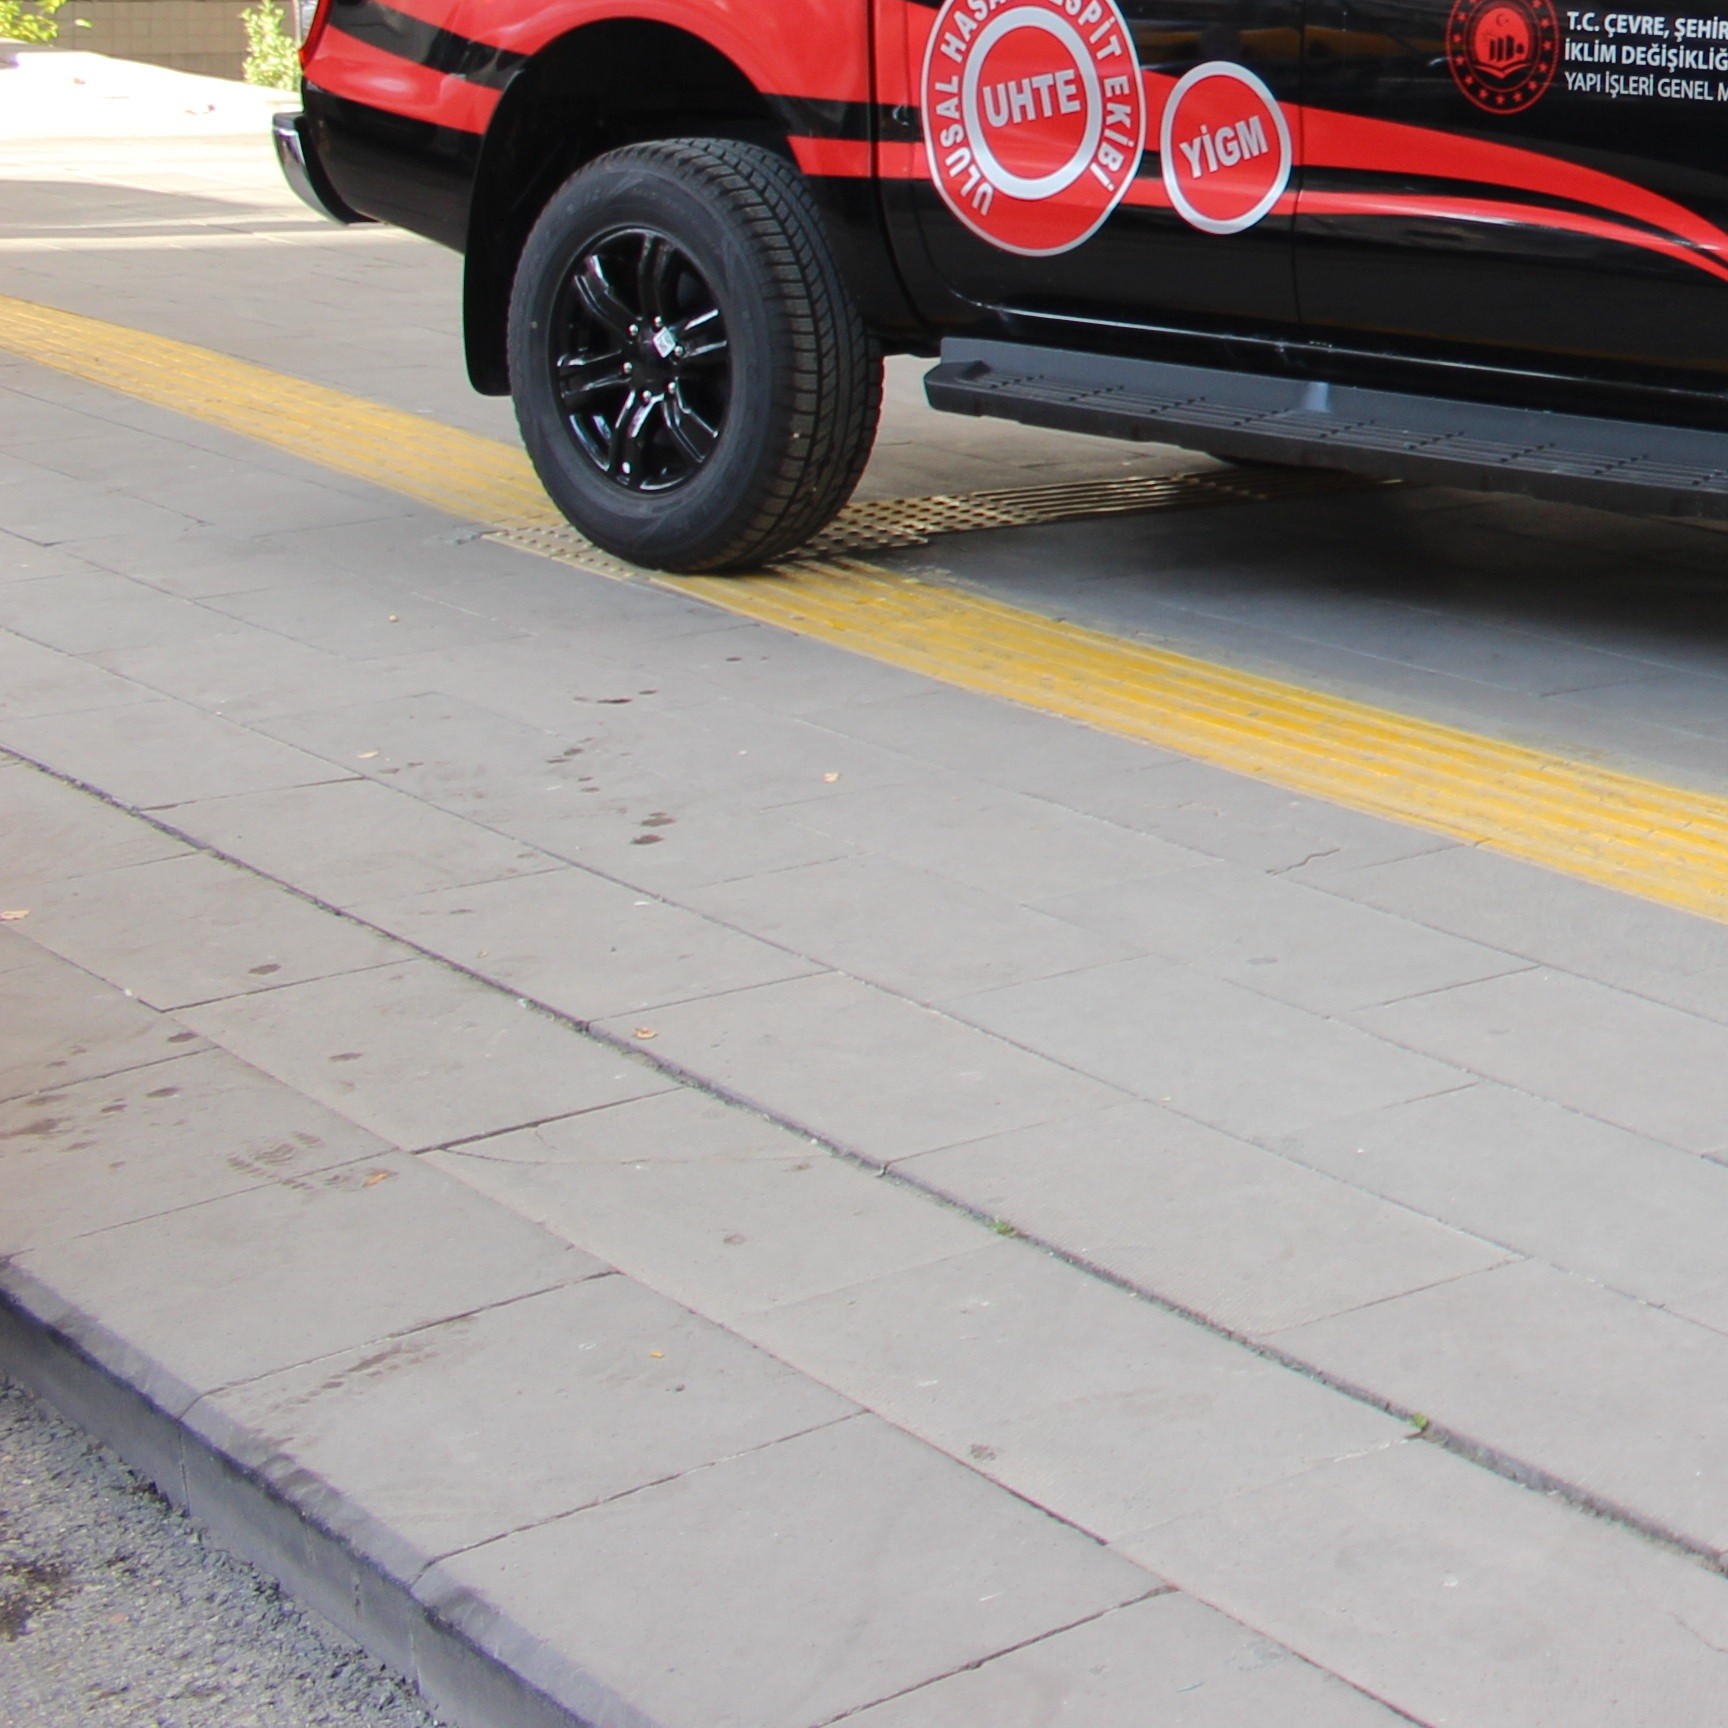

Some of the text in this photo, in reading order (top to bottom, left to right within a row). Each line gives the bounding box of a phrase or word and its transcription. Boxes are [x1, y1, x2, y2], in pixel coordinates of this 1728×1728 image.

[1566, 10, 1600, 33] T.C.
[1603, 13, 1671, 39] ÇEVRE,
[1564, 38, 1618, 64] İKLİM
[982, 69, 1081, 128] UHTE
[1565, 72, 1602, 93] YAPI
[1605, 71, 1654, 100] İŞLERİ
[1658, 78, 1714, 102] GENEL
[935, 75, 995, 216] ULUSAL
[1090, 75, 1134, 192] EKİBİ
[1178, 115, 1270, 180] YİGM
